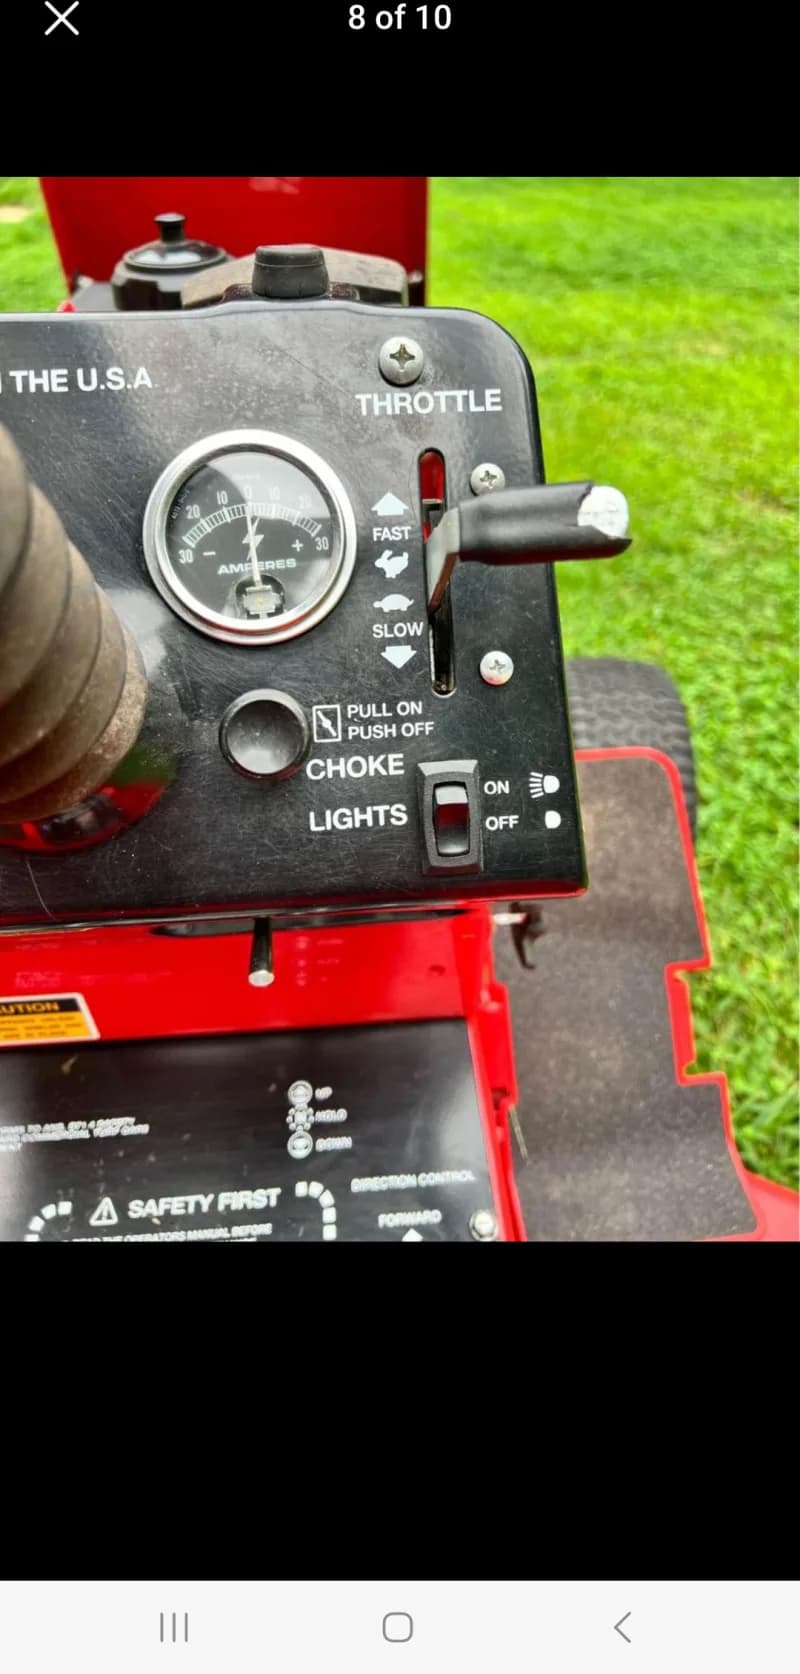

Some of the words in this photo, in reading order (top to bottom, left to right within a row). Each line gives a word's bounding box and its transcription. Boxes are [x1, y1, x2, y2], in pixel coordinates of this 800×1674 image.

[9, 368, 69, 393] THE
[355, 388, 503, 416] THROTTLE
[216, 490, 228, 505] 10
[185, 504, 200, 519] 20
[372, 525, 412, 542] FAST
[315, 537, 329, 551] 30
[178, 549, 194, 565] 30
[217, 558, 297, 575] AMPERES
[372, 621, 424, 638] SLOW
[347, 702, 392, 719] PULL
[397, 701, 423, 716] ON
[347, 723, 397, 740] PUSH
[402, 721, 435, 738] OFF
[306, 753, 405, 780] CHOKE
[484, 780, 510, 795] ON
[309, 803, 408, 832] LIGHTS
[485, 815, 519, 831] OFF
[128, 1193, 215, 1218] SAFETY
[217, 1188, 281, 1211] FIRST
[378, 1209, 442, 1228] FORWARD
